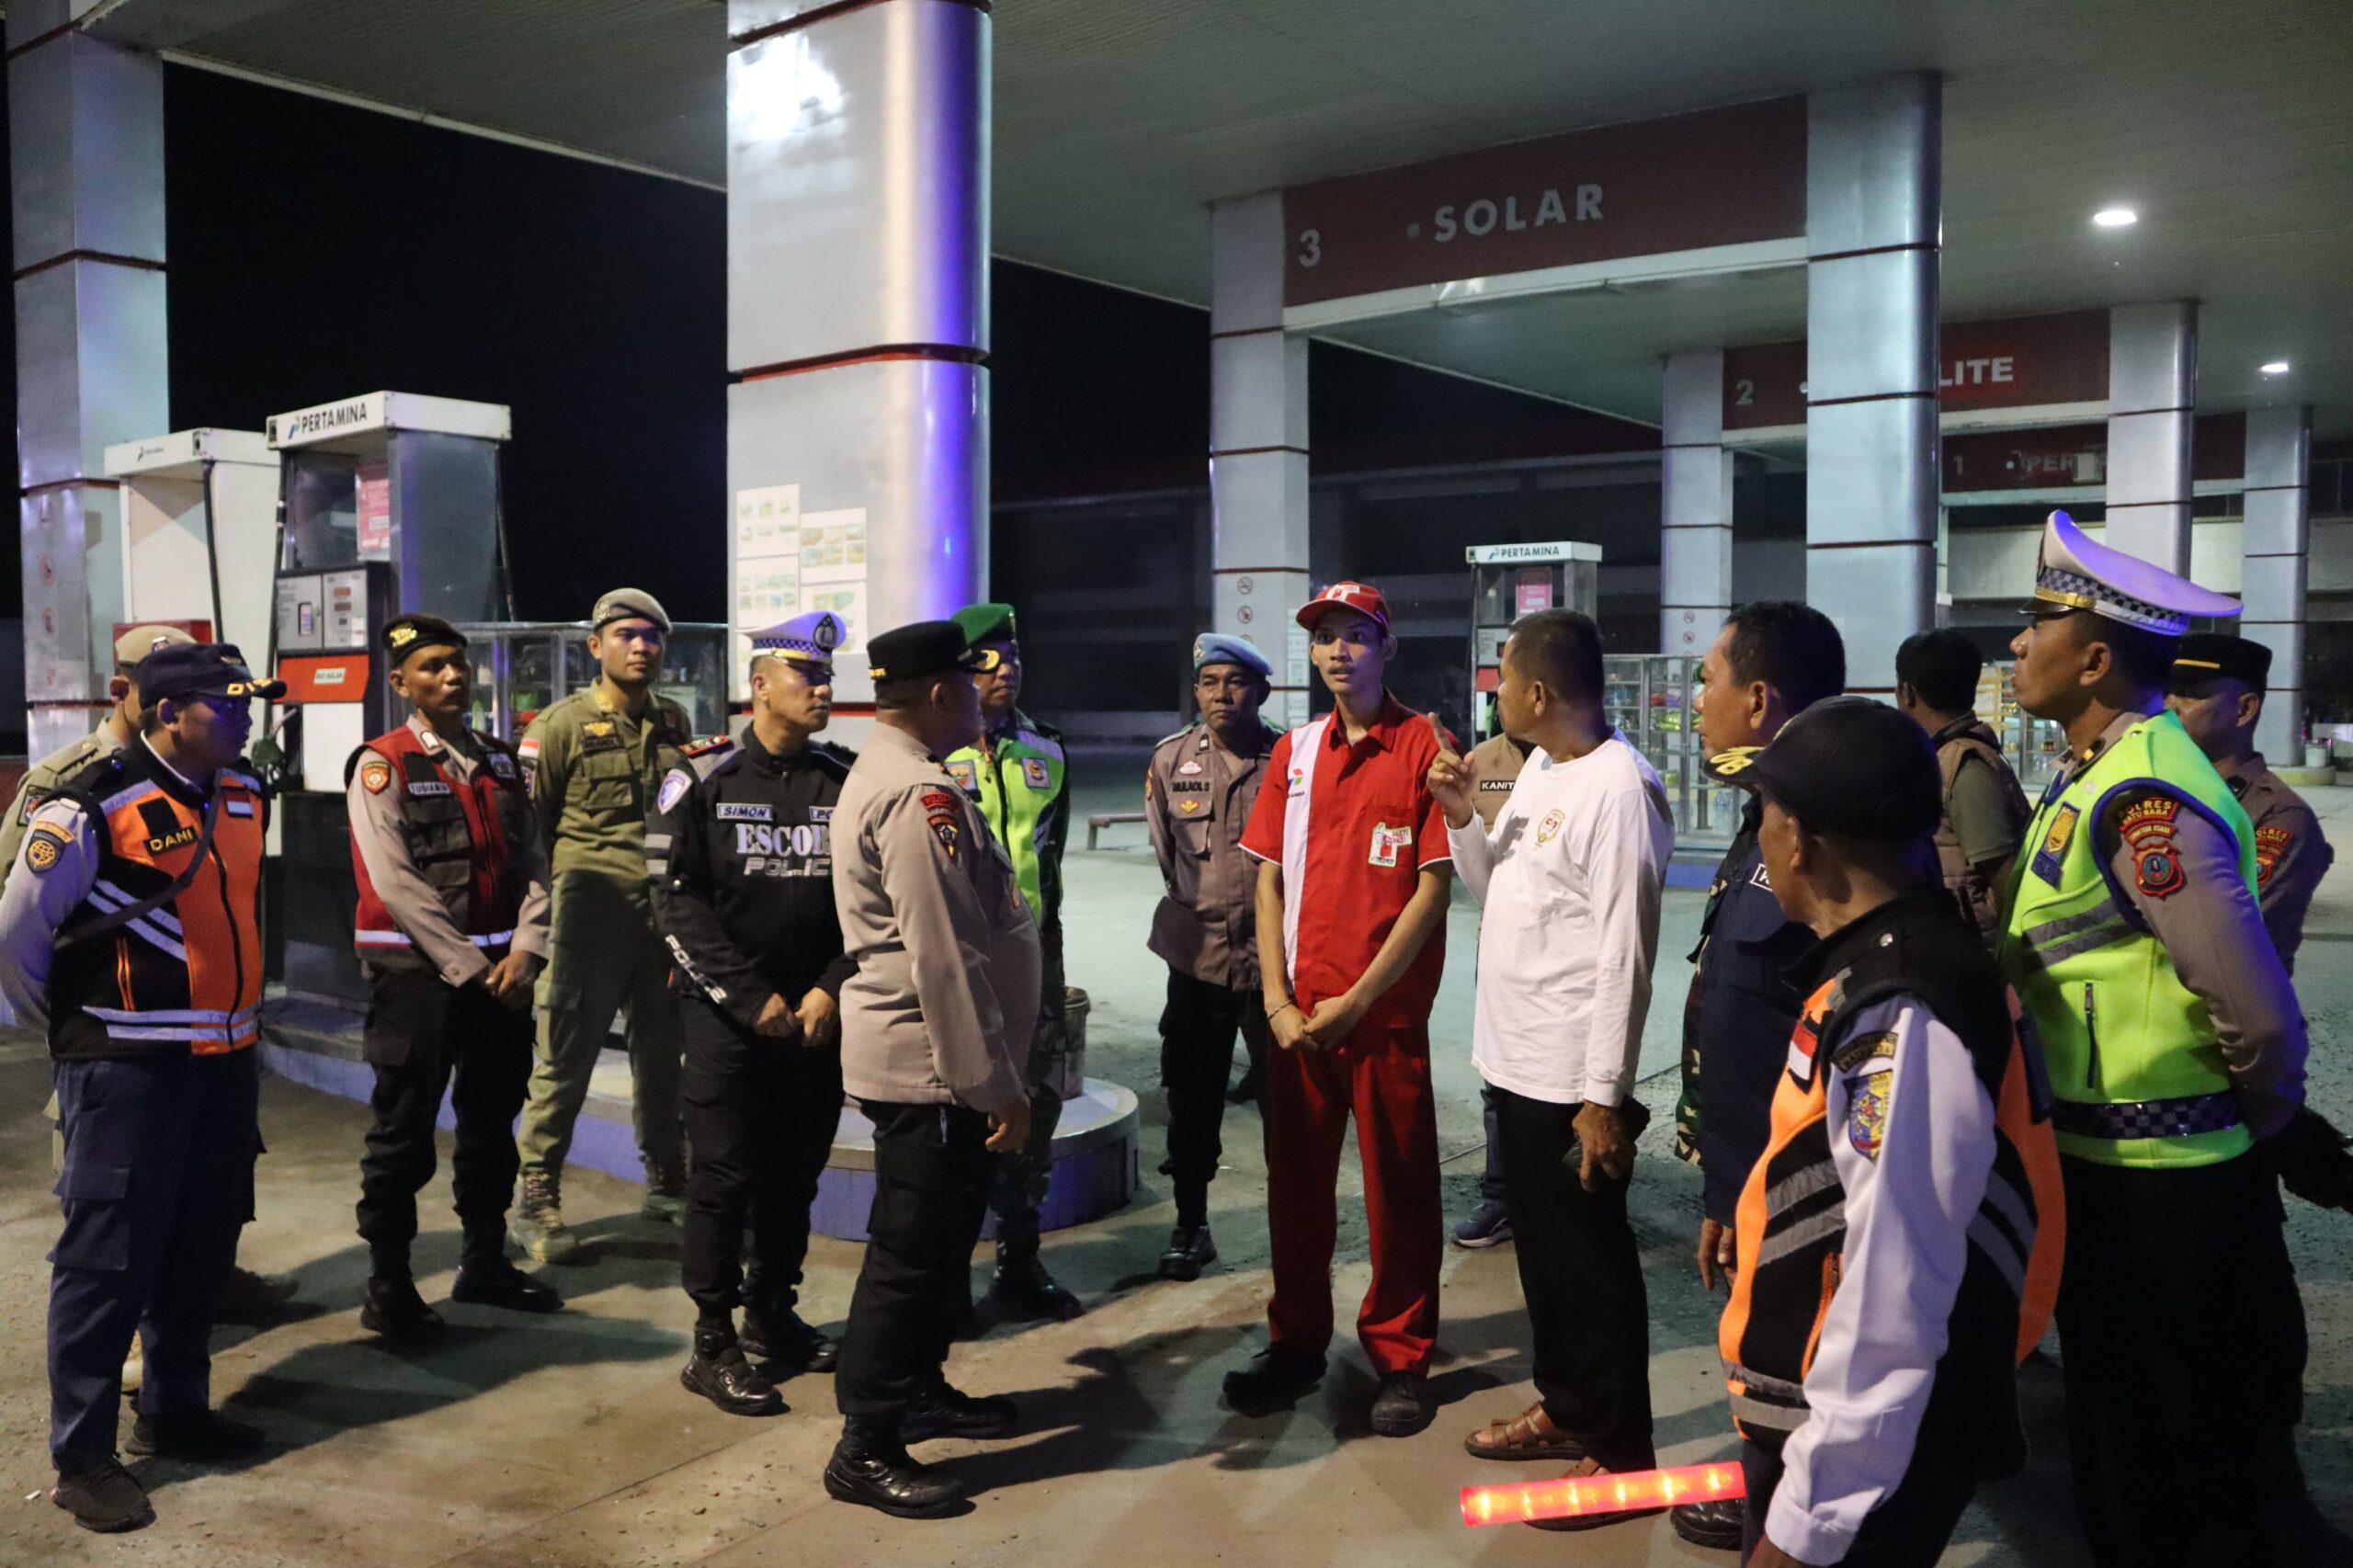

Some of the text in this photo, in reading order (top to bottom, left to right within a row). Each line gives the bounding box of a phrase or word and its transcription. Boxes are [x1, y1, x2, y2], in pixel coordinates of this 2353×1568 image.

[1299, 183, 1604, 267] 3 SOLAR
[1735, 378, 1755, 406] 2
[301, 403, 368, 434] PERTAMINA
[1501, 546, 1560, 558] PERTAMINA
[723, 806, 767, 817] SIMON
[2143, 808, 2168, 816] BARA
[150, 829, 194, 852] DANI
[735, 824, 832, 857] ESCOR
[744, 857, 831, 877] POLIC
